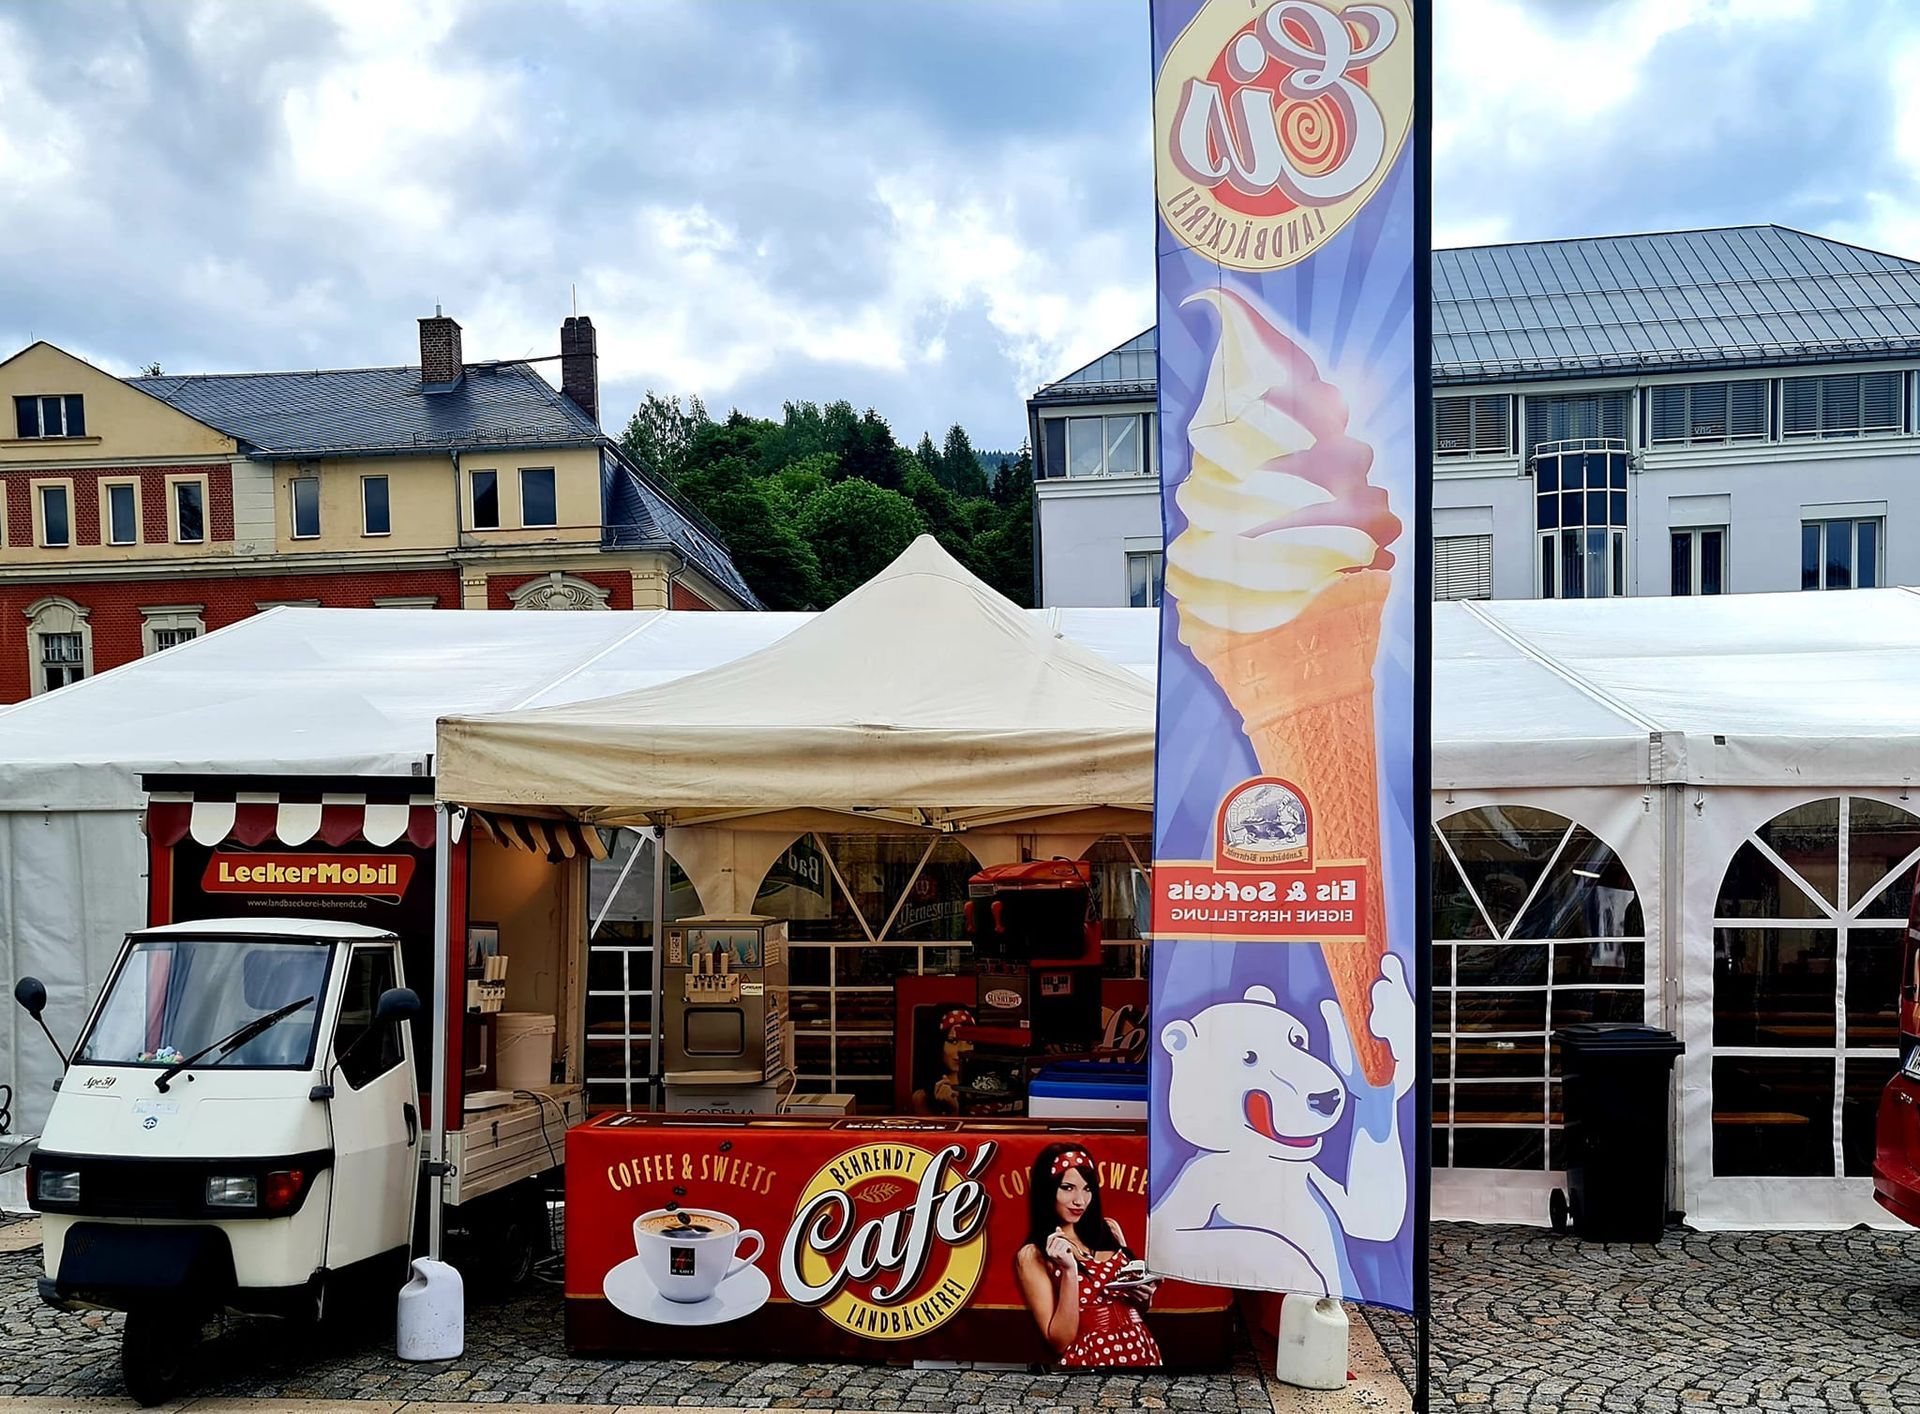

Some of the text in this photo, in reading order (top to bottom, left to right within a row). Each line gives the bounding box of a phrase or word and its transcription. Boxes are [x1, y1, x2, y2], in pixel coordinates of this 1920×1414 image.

[218, 862, 398, 885] LeckerMobil
[246, 898, 368, 909] www.landbaeckerei-behrendt.de
[607, 1153, 777, 1195] COFFEE & SWEETS
[829, 1148, 916, 1186] BEHRENDT
[1098, 1161, 1148, 1195] SWEE
[779, 1141, 998, 1304] Café
[846, 1278, 966, 1334] LANDBÄCKEREI
